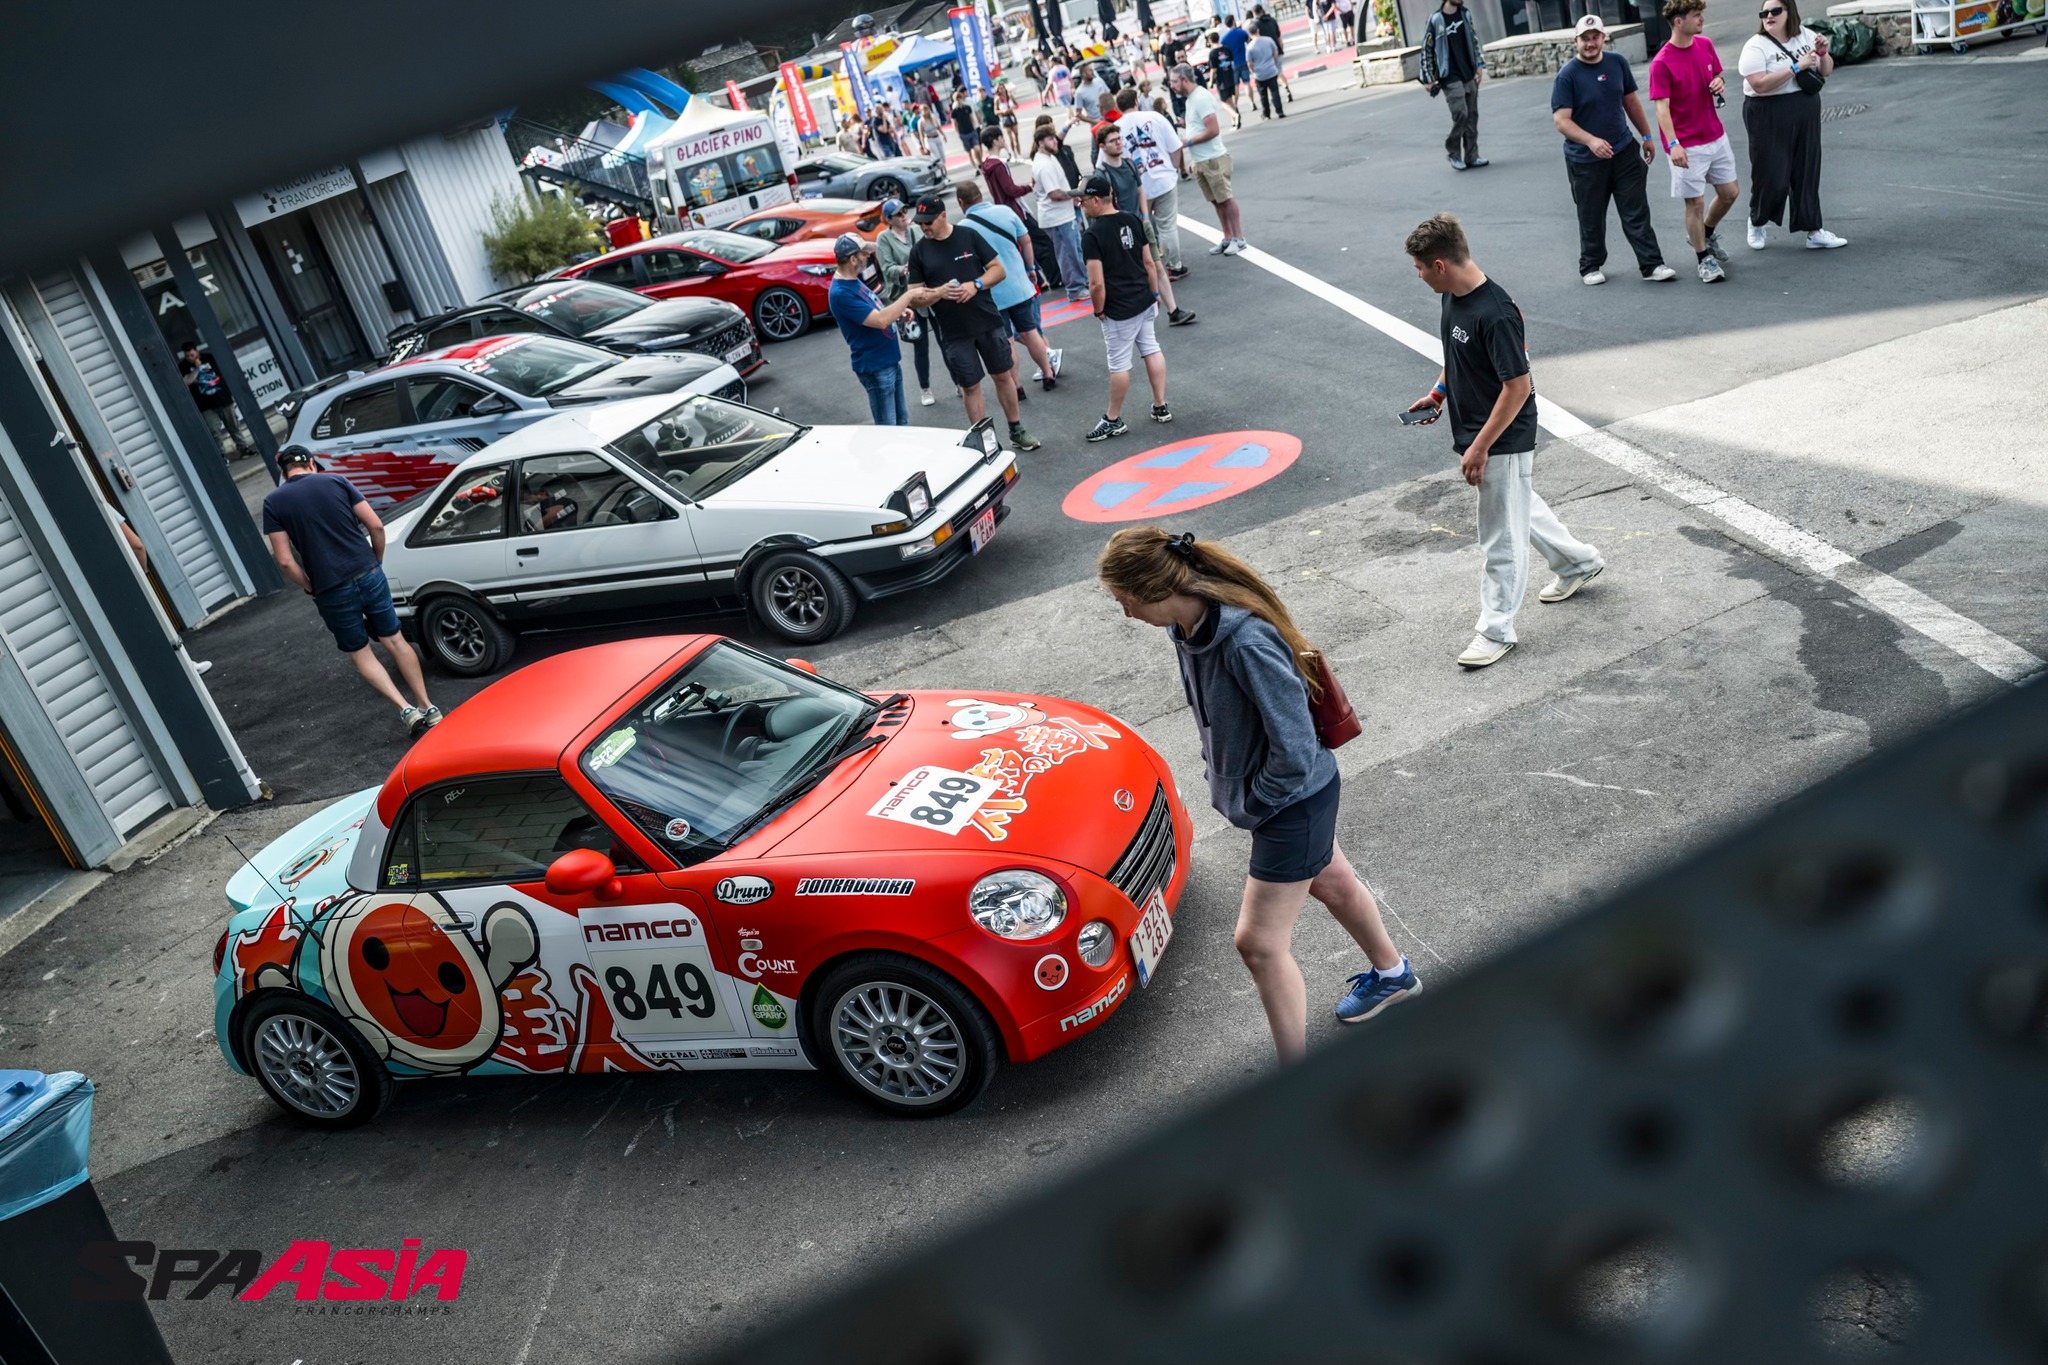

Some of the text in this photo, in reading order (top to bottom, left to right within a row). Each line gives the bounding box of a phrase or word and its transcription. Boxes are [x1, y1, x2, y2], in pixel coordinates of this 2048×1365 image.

[677, 135, 730, 161] GLACIER
[733, 125, 763, 146] PINO
[877, 770, 930, 817] namco
[910, 776, 981, 826] 849
[719, 879, 770, 900] Drum
[583, 919, 692, 943] namco
[1151, 916, 1169, 959] 481
[605, 962, 716, 1021] 849
[753, 1004, 783, 1012] GIDDO
[1060, 977, 1126, 1032] namco
